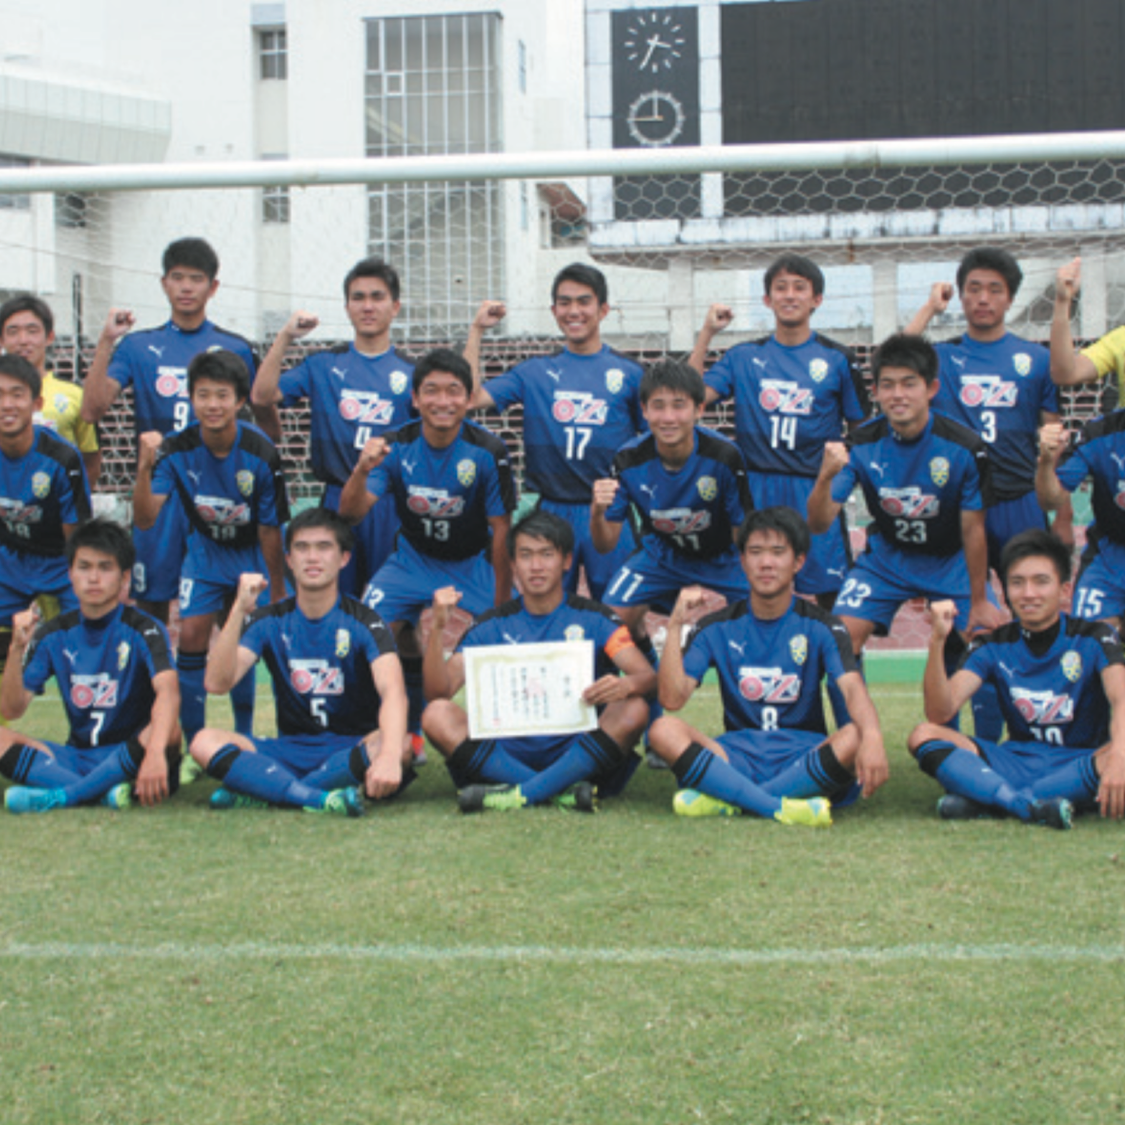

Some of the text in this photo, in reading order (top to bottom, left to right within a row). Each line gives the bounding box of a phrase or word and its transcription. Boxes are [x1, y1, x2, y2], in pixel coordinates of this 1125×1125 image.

[173, 401, 190, 432] 9
[980, 411, 997, 444] 3
[564, 427, 593, 460] 17
[769, 416, 798, 450] 14
[421, 518, 450, 542] 13
[895, 520, 927, 543] 23
[133, 562, 147, 592] 9
[609, 567, 644, 602] 11
[836, 578, 872, 607] 23
[1077, 587, 1105, 618] 15
[310, 697, 328, 727] 5
[90, 711, 104, 747] 7
